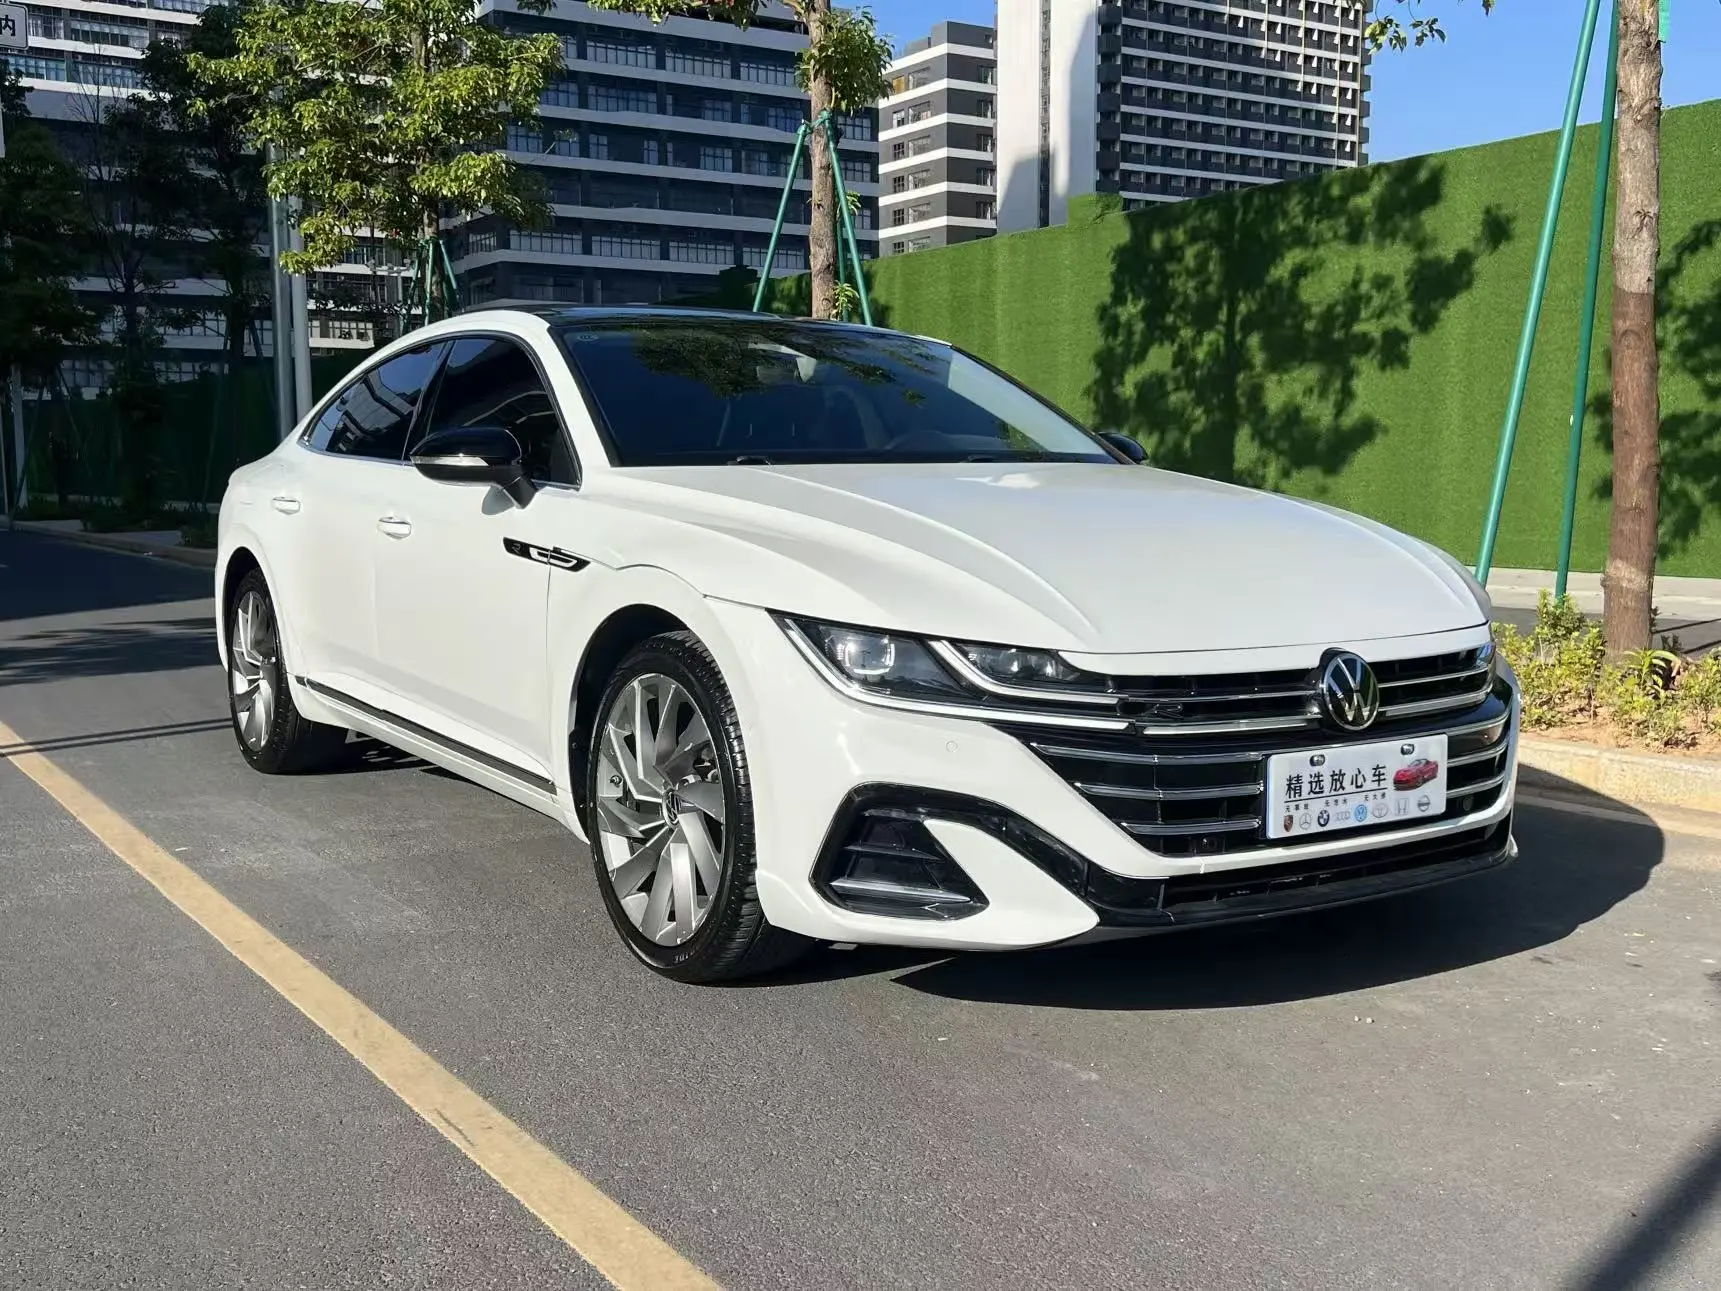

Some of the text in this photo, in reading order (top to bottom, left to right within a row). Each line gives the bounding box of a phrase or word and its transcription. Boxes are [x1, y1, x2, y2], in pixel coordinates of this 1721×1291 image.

[0, 14, 16, 37] 内
[1285, 764, 1387, 799] 精选放心车
